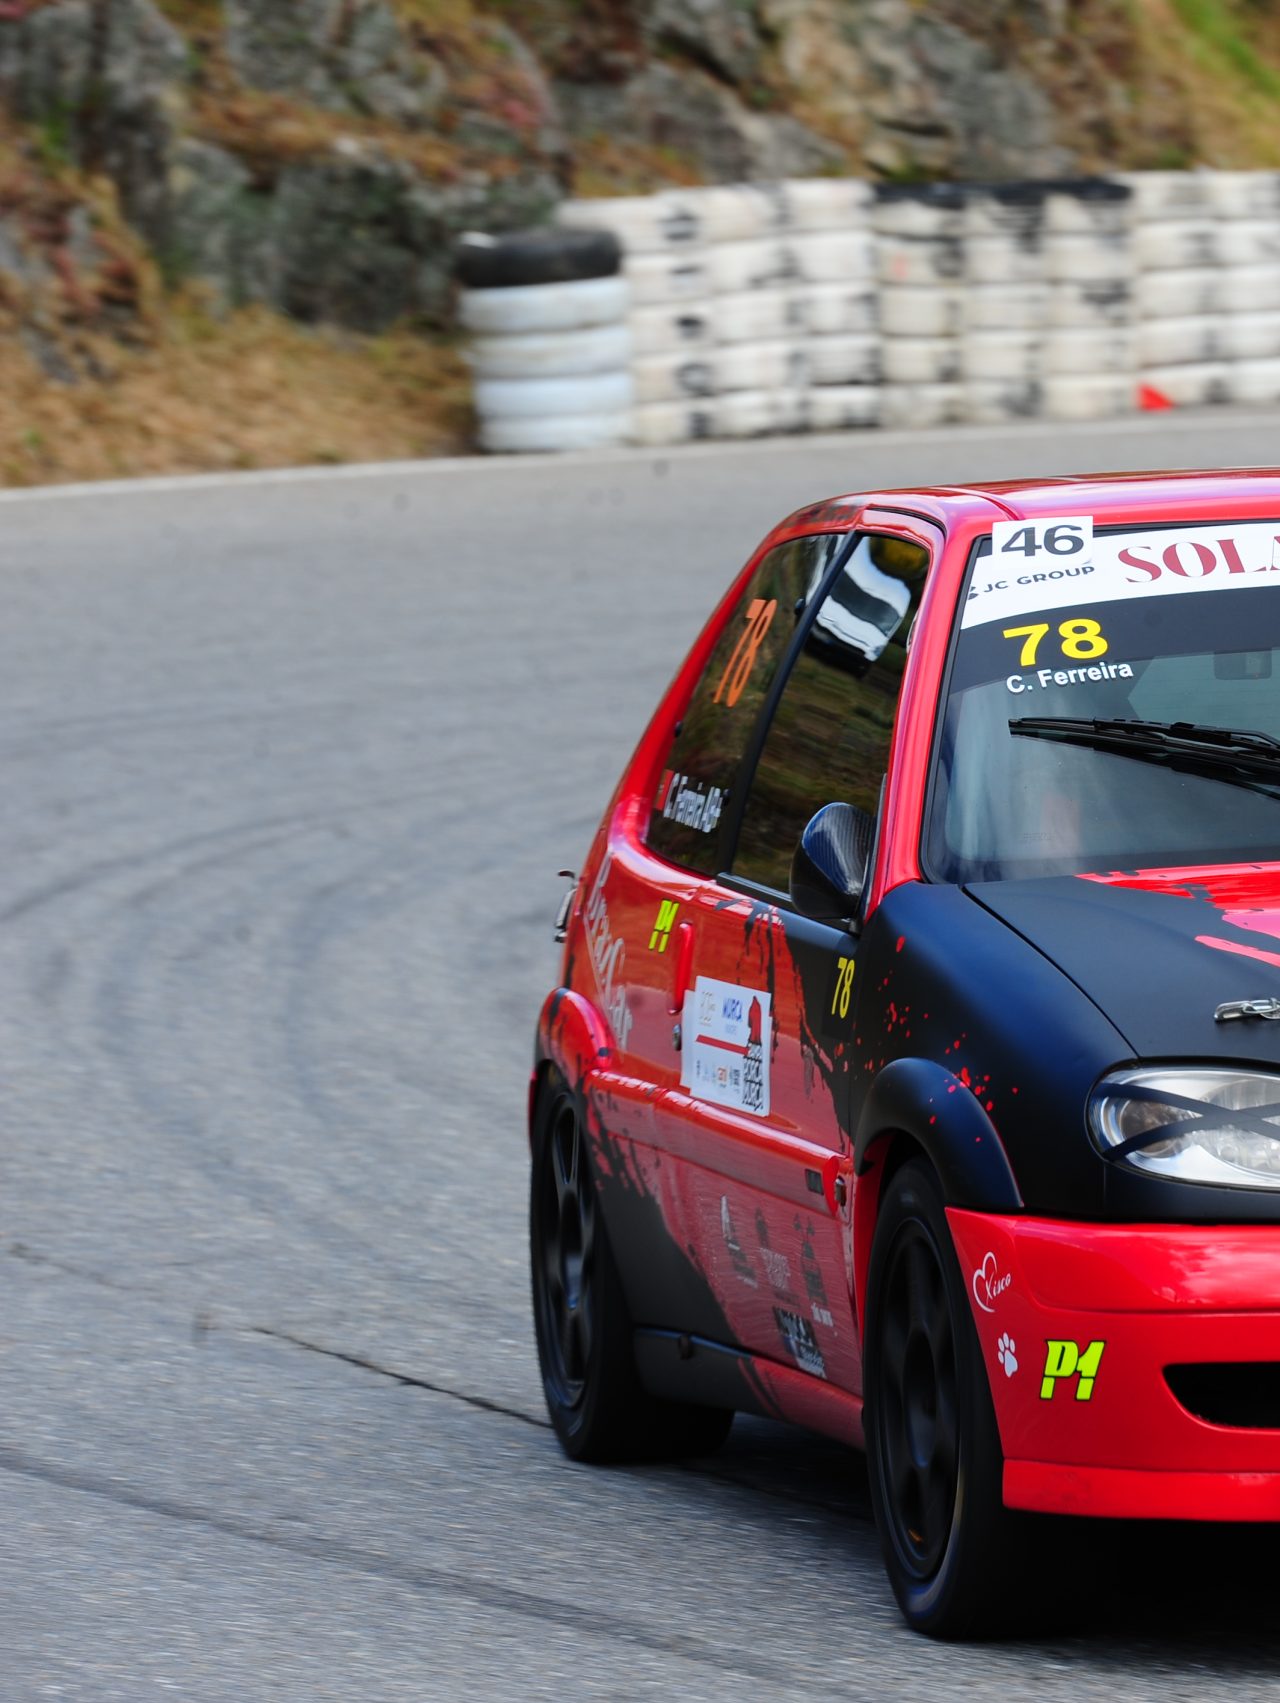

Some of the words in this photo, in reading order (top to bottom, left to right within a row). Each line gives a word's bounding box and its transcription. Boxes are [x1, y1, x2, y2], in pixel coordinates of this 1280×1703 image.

[1001, 524, 1084, 557] 46
[983, 580, 1009, 593] JC
[1016, 565, 1096, 585] GROUP
[713, 599, 778, 709] 78
[1002, 618, 1109, 667] 78
[1006, 675, 1033, 693] C.
[1037, 661, 1134, 688] Ferreira
[831, 956, 855, 1019] 78
[1039, 1339, 1107, 1401] P1
